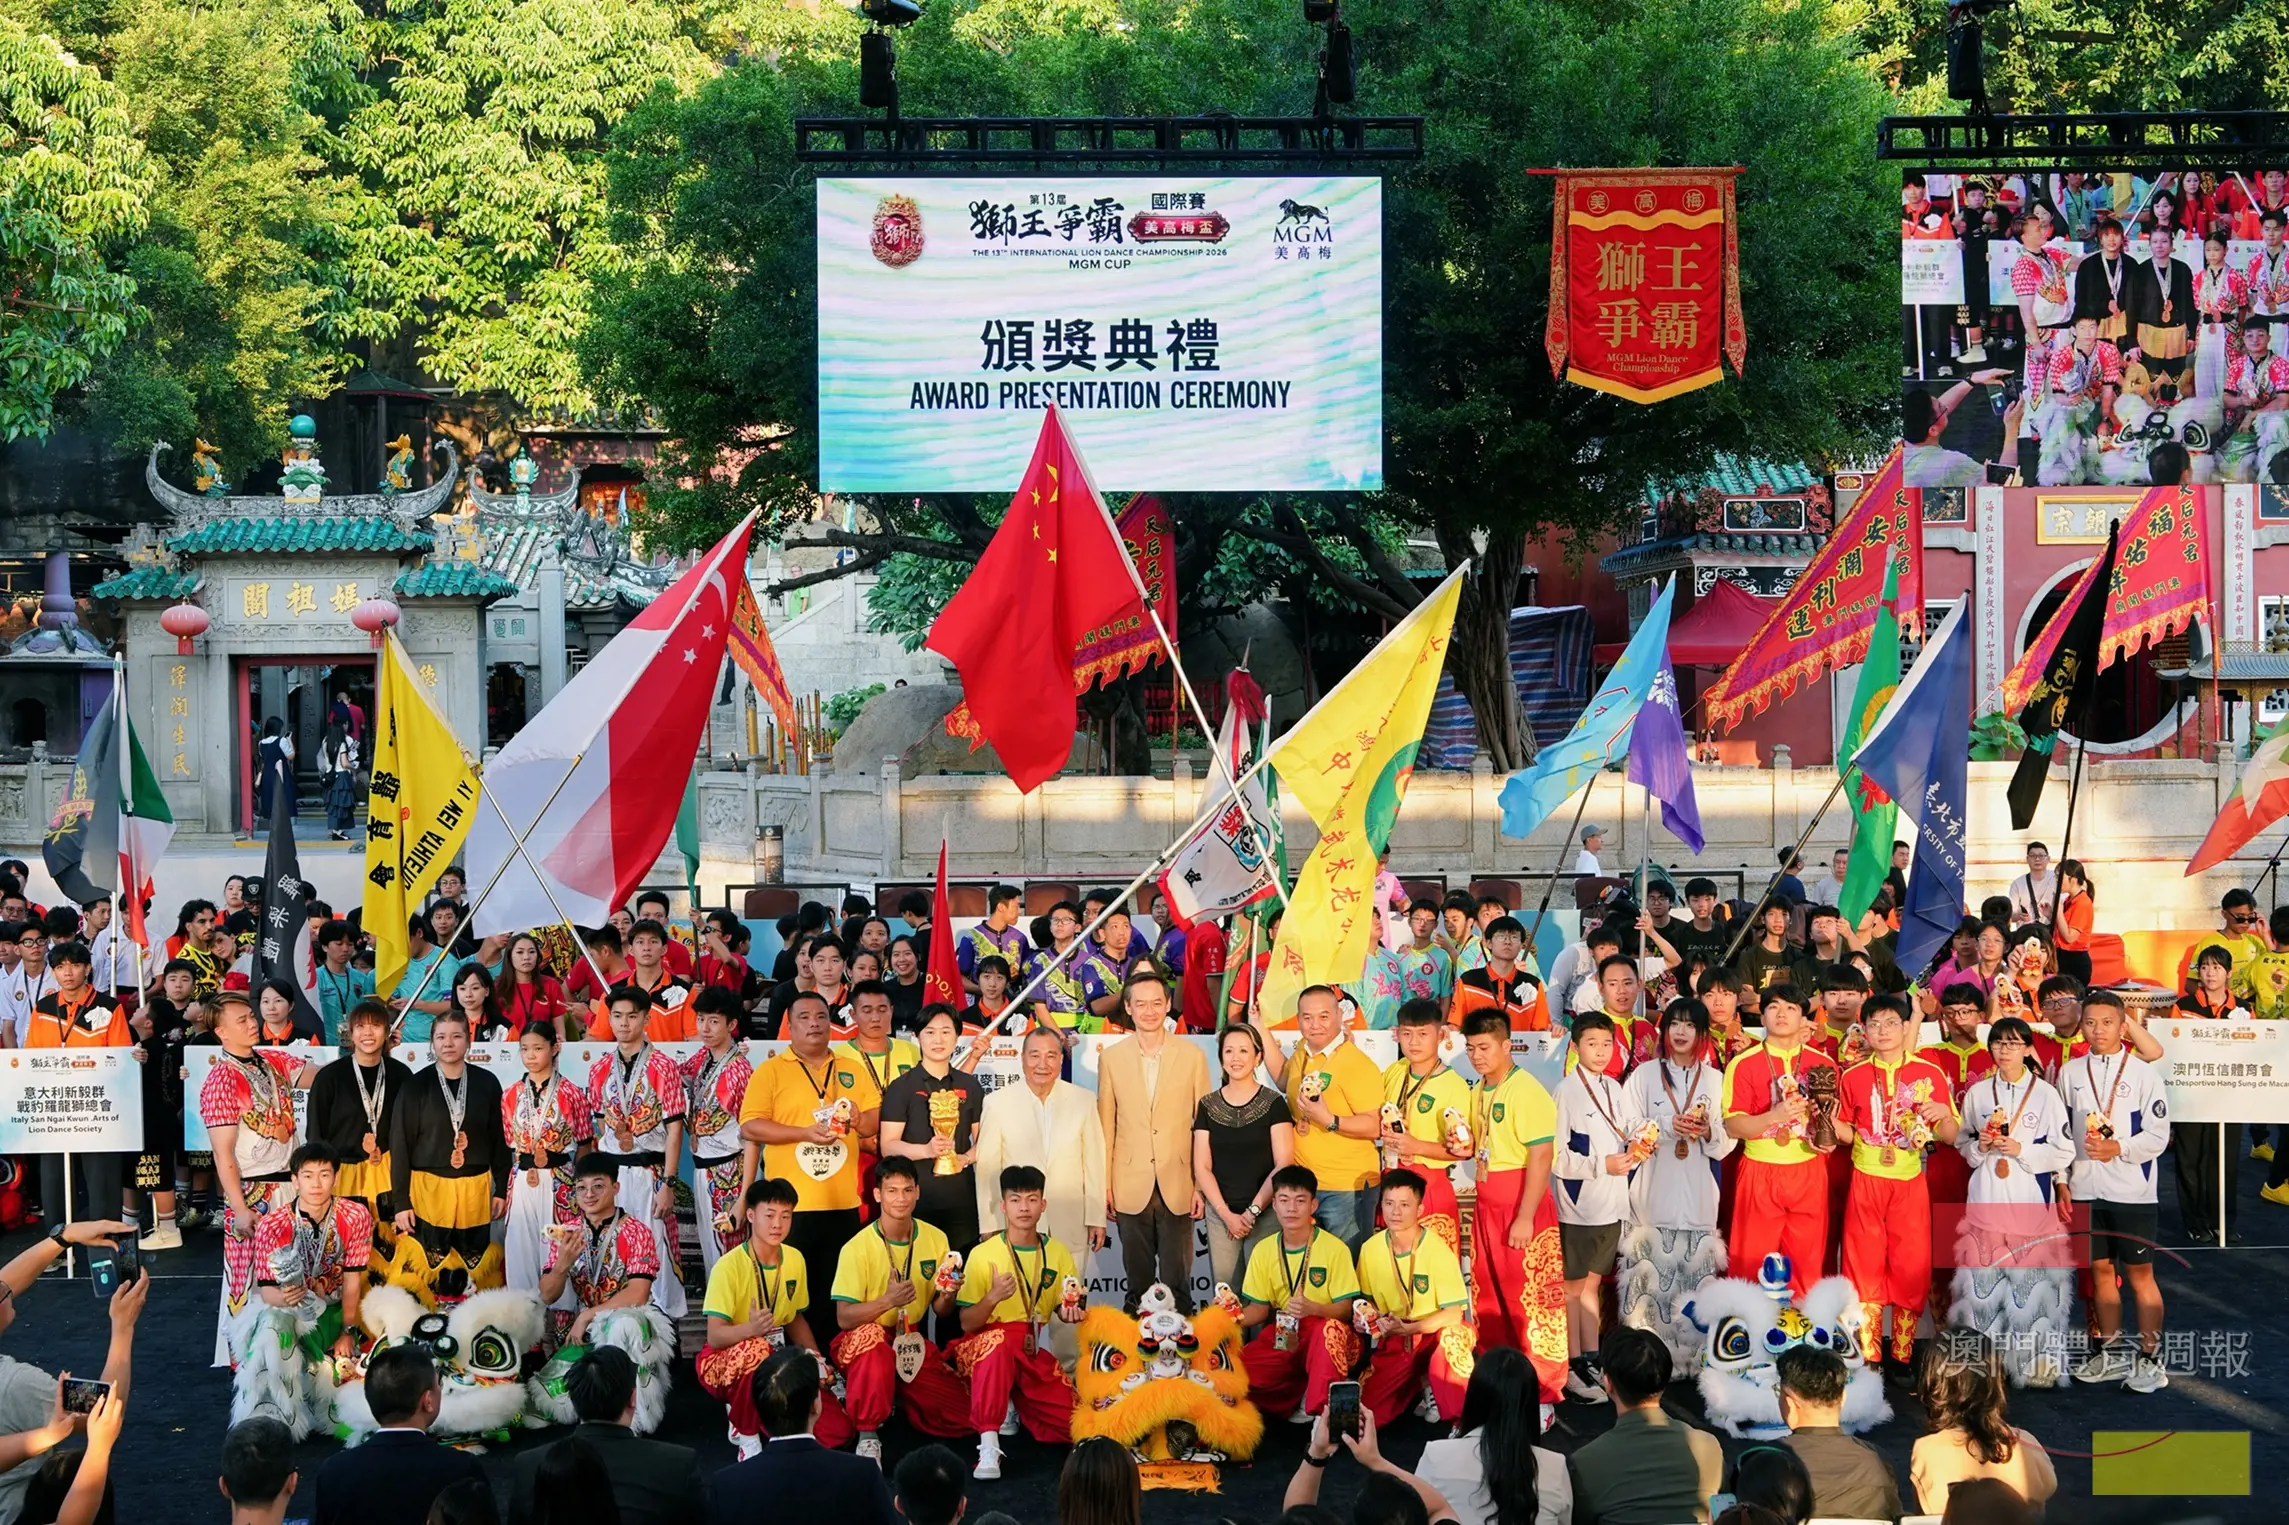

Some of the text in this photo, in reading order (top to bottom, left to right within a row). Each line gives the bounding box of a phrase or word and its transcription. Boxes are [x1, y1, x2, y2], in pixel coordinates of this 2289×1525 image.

[1029, 193, 1067, 206] 第13屆
[1151, 193, 1206, 211] 國際賽
[1590, 192, 1702, 210] 美高梅
[970, 197, 1125, 246] 獅王爭霸
[1144, 220, 1214, 235] 美高梅盃
[1273, 226, 1333, 243] MGM
[973, 249, 989, 257] THE
[1010, 249, 1078, 257] INTERNATIONAL
[1081, 249, 1101, 257] LION
[1104, 249, 1134, 257] DANCE
[1136, 249, 1204, 257] CHAMPIONSHIP
[1206, 249, 1228, 257] 2026
[1275, 246, 1331, 260] 美高梅
[1069, 259, 1131, 269] MGM CUP
[1595, 241, 1703, 292] 獅王
[1595, 298, 1701, 349] 爭霸
[980, 318, 1220, 372] 頒獎典禮
[1606, 353, 1688, 363] MGM Lion Dance
[1612, 361, 1680, 374] Championship
[911, 381, 1292, 409] AWARD PRESENTATION CEREMONY
[1893, 489, 1912, 576] 天后元君
[1144, 514, 1164, 603] 天后元君
[243, 581, 363, 619] 媽祖閣
[1822, 592, 1882, 626] 澳門媽閣
[1945, 855, 1957, 869] OF
[2173, 1063, 2272, 1077] 澳門恆信體育會
[2175, 1079, 2215, 1087] Desportivo
[2217, 1080, 2237, 1088] Hang
[2238, 1080, 2257, 1089] Sung
[24, 1085, 105, 1099] 意大利新毅群
[17, 1099, 112, 1113] 戰豹羅龍獅總會
[11, 1116, 29, 1124] Italy
[47, 1115, 65, 1124] Ngai
[74, 1125, 103, 1134] Society
